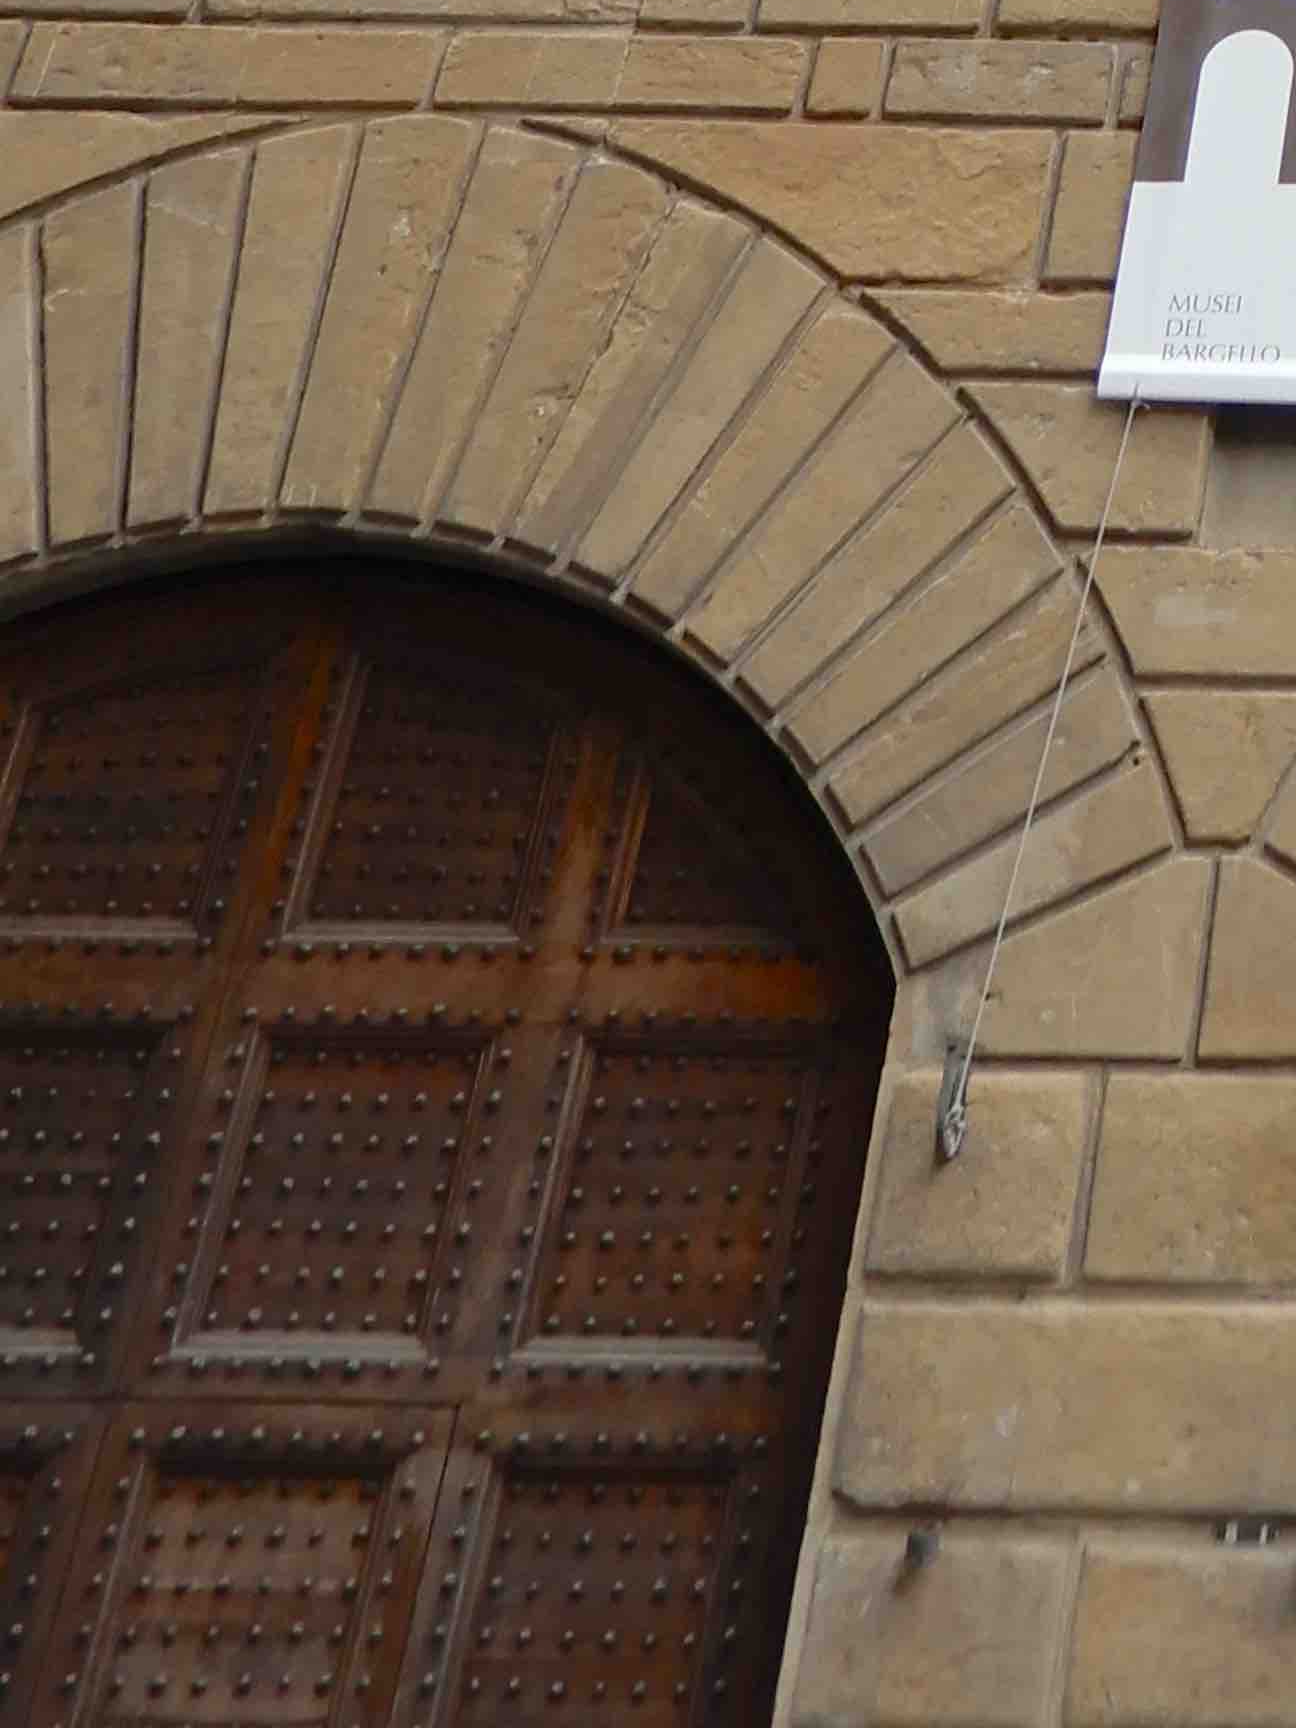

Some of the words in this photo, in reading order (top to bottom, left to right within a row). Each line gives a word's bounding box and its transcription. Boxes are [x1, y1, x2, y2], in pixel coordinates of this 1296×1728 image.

[1167, 294, 1243, 313] MUSEI
[1164, 319, 1206, 337] DEL
[1160, 343, 1281, 362] BARGELLO
